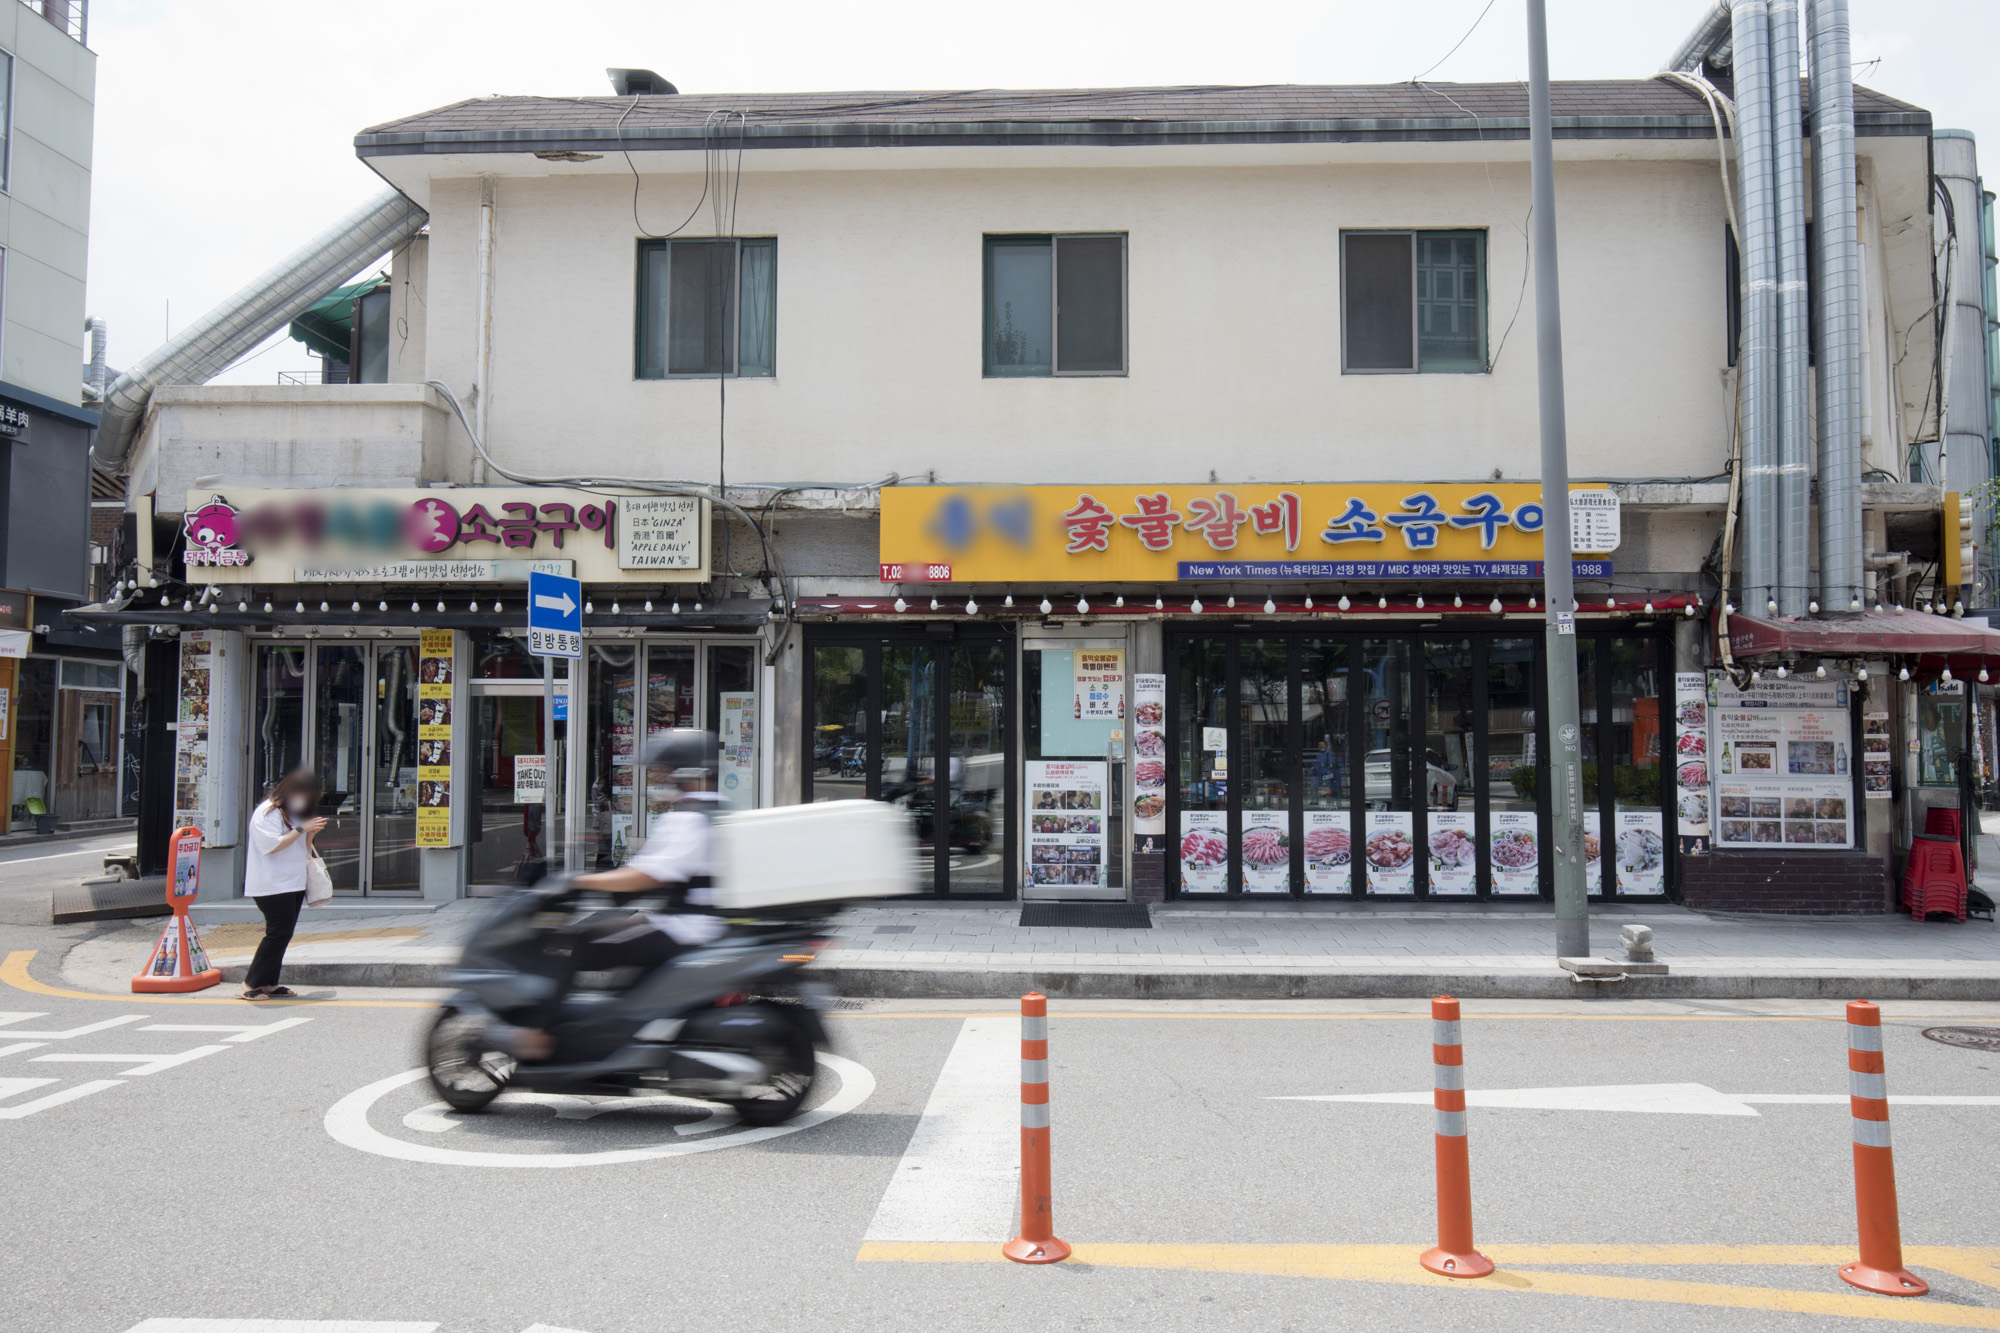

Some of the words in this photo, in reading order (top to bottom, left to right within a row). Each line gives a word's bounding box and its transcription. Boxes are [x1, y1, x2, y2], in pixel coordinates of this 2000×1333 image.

[678, 501, 694, 512] 선정
[459, 500, 615, 549] 소금구이
[633, 517, 650, 527] 日本
[1062, 491, 1301, 554] 숯불갈비
[633, 530, 650, 541] 香港
[186, 551, 247, 566] 돼지저금통
[631, 555, 675, 565] TAIWAN
[372, 565, 408, 578] 프로그램
[450, 563, 486, 578] 선정업소
[928, 565, 950, 579] 8806
[1189, 565, 1214, 575] New
[1217, 565, 1241, 575] York
[1244, 565, 1278, 575] Times
[1279, 564, 1333, 576] (뉴욕타임즈)
[1335, 564, 1355, 575] 선정
[1357, 564, 1376, 575] 맛집
[1387, 565, 1410, 575] MBC
[1411, 564, 1441, 575] 찾아라
[1443, 564, 1472, 575] 맛있는
[1473, 564, 1489, 576] TV,
[1490, 564, 1529, 575] 화제집중
[1576, 564, 1602, 575] 1988
[1560, 624, 1572, 632] 1-1
[531, 631, 580, 652] 일방통행
[1939, 683, 1959, 692] sahi
[517, 768, 533, 780] TAKE
[533, 768, 546, 780] OUT
[178, 842, 199, 853] 주차금지
